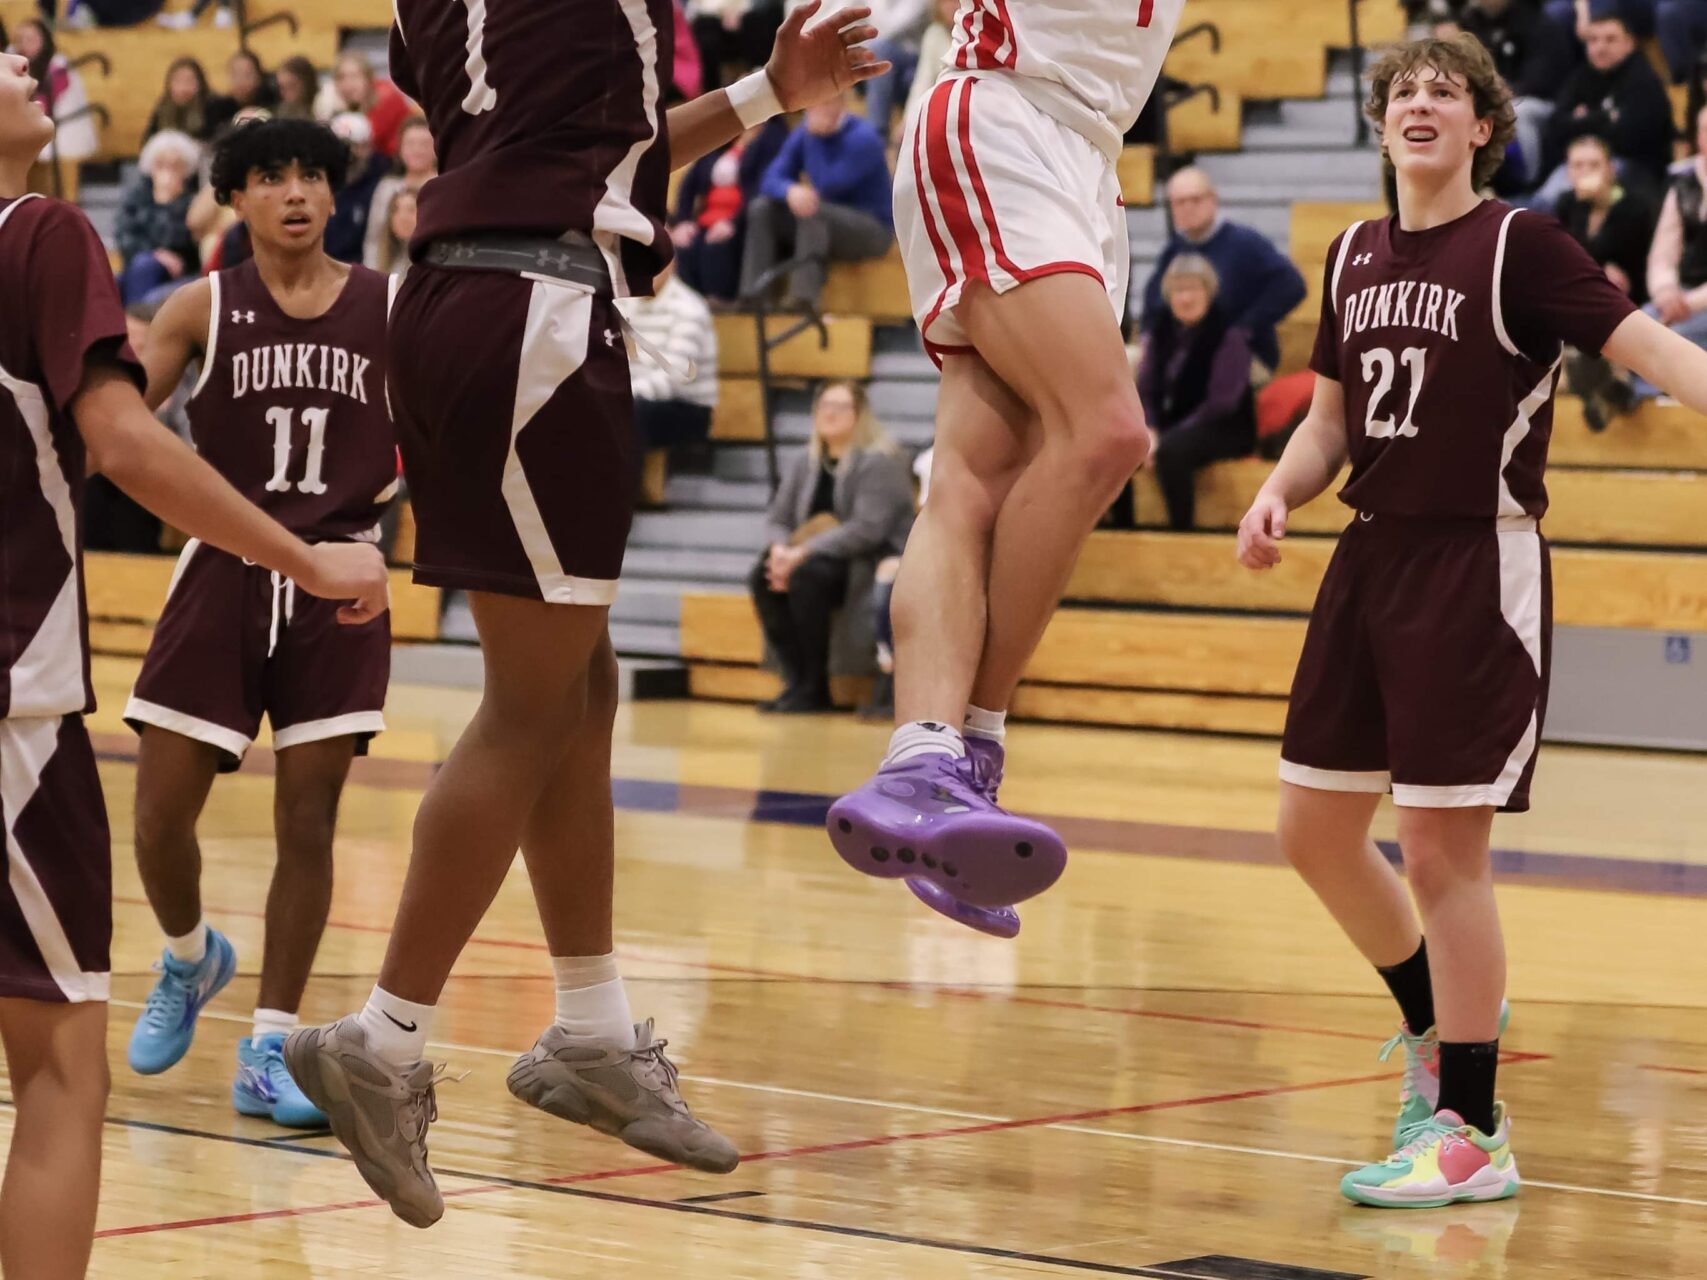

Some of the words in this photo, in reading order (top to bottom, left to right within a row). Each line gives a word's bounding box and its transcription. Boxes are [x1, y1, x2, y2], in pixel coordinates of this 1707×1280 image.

[1343, 280, 1466, 343] DUNKIRK
[232, 343, 371, 405] DUNKIRK
[1360, 346, 1427, 439] 21
[265, 406, 330, 495] 11
